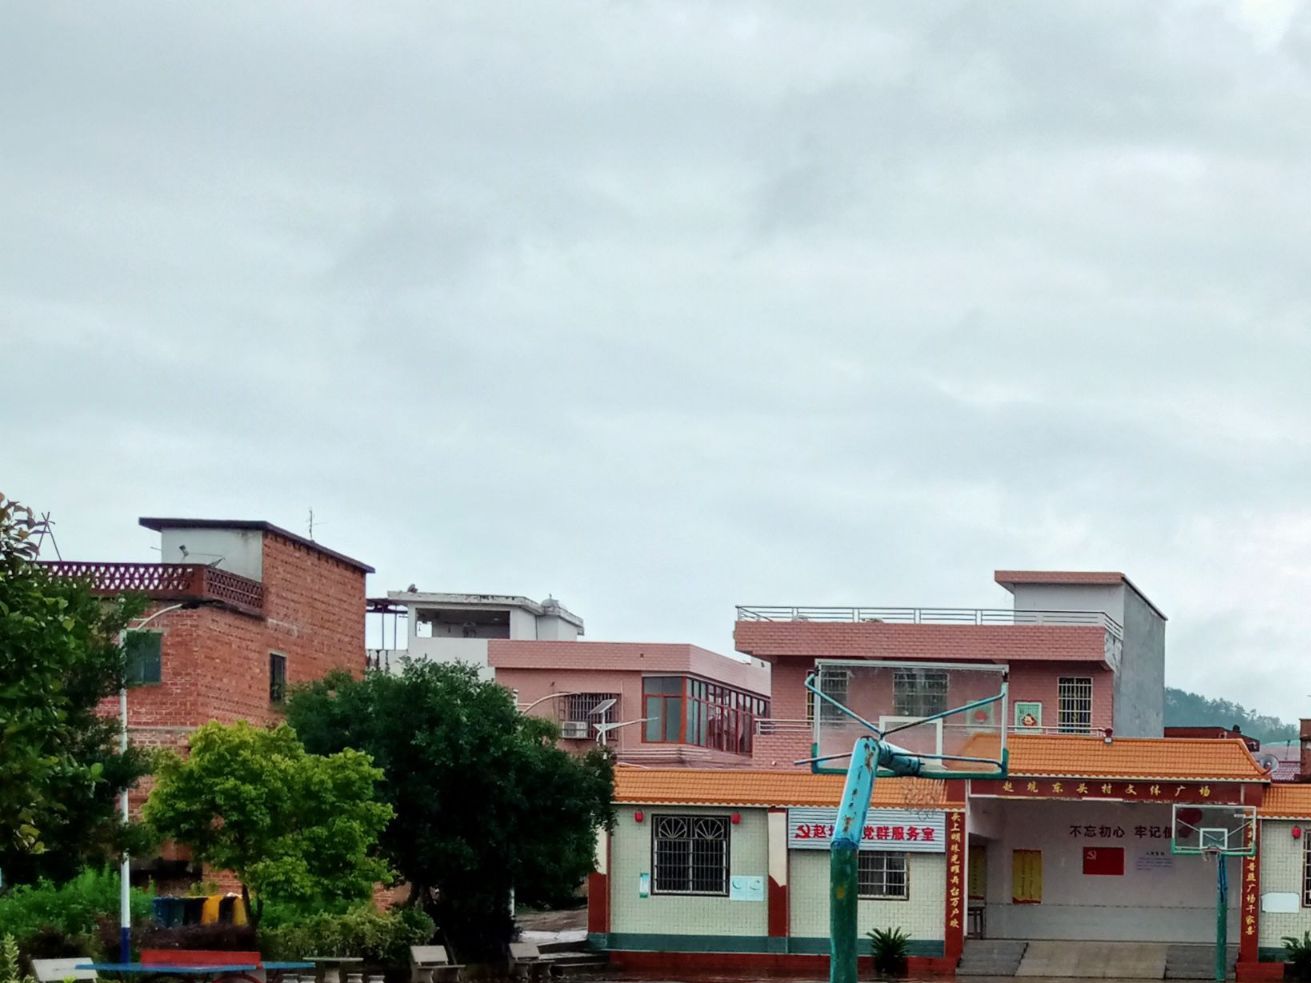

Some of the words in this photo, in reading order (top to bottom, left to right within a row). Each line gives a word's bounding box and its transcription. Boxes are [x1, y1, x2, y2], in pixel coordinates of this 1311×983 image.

[813, 824, 935, 841] 赵党群服务室
[1069, 824, 1126, 838] 不忘初心
